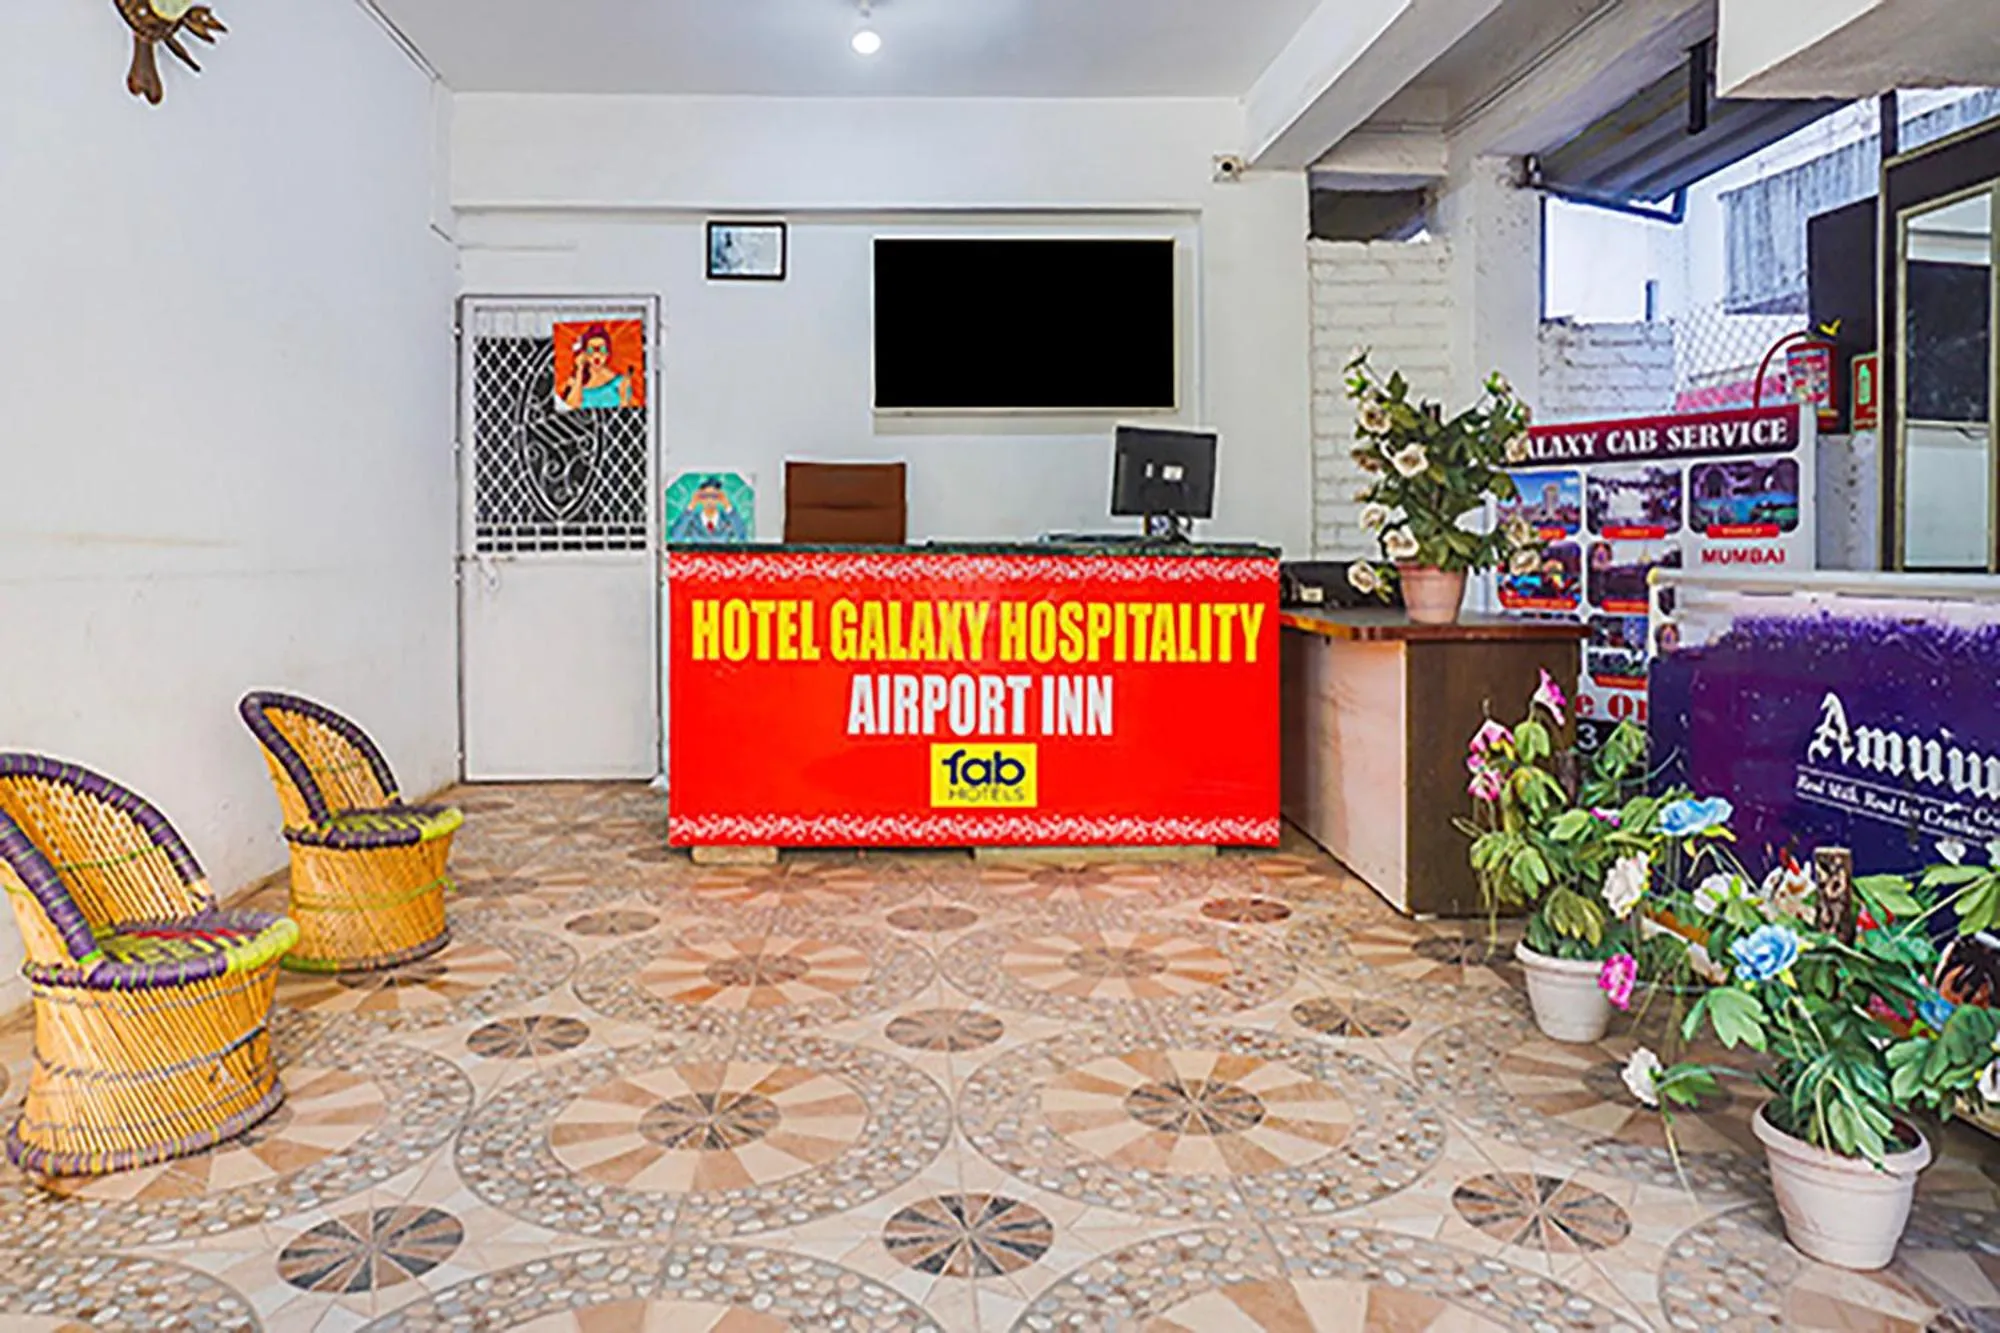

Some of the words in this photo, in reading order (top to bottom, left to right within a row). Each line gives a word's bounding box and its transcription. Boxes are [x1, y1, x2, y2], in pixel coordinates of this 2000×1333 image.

[1526, 432, 1598, 460] ALAXY
[1606, 428, 1658, 453] CAB
[1666, 417, 1787, 449] SERVICE
[691, 599, 820, 662] HOTEL
[829, 599, 989, 662] GALAXY
[1000, 601, 1265, 664] HOSPITALITY
[847, 673, 1032, 737] AIRPORT
[1040, 675, 1114, 737] INN
[941, 749, 1025, 786] fab
[948, 786, 1026, 803] HOTELS
